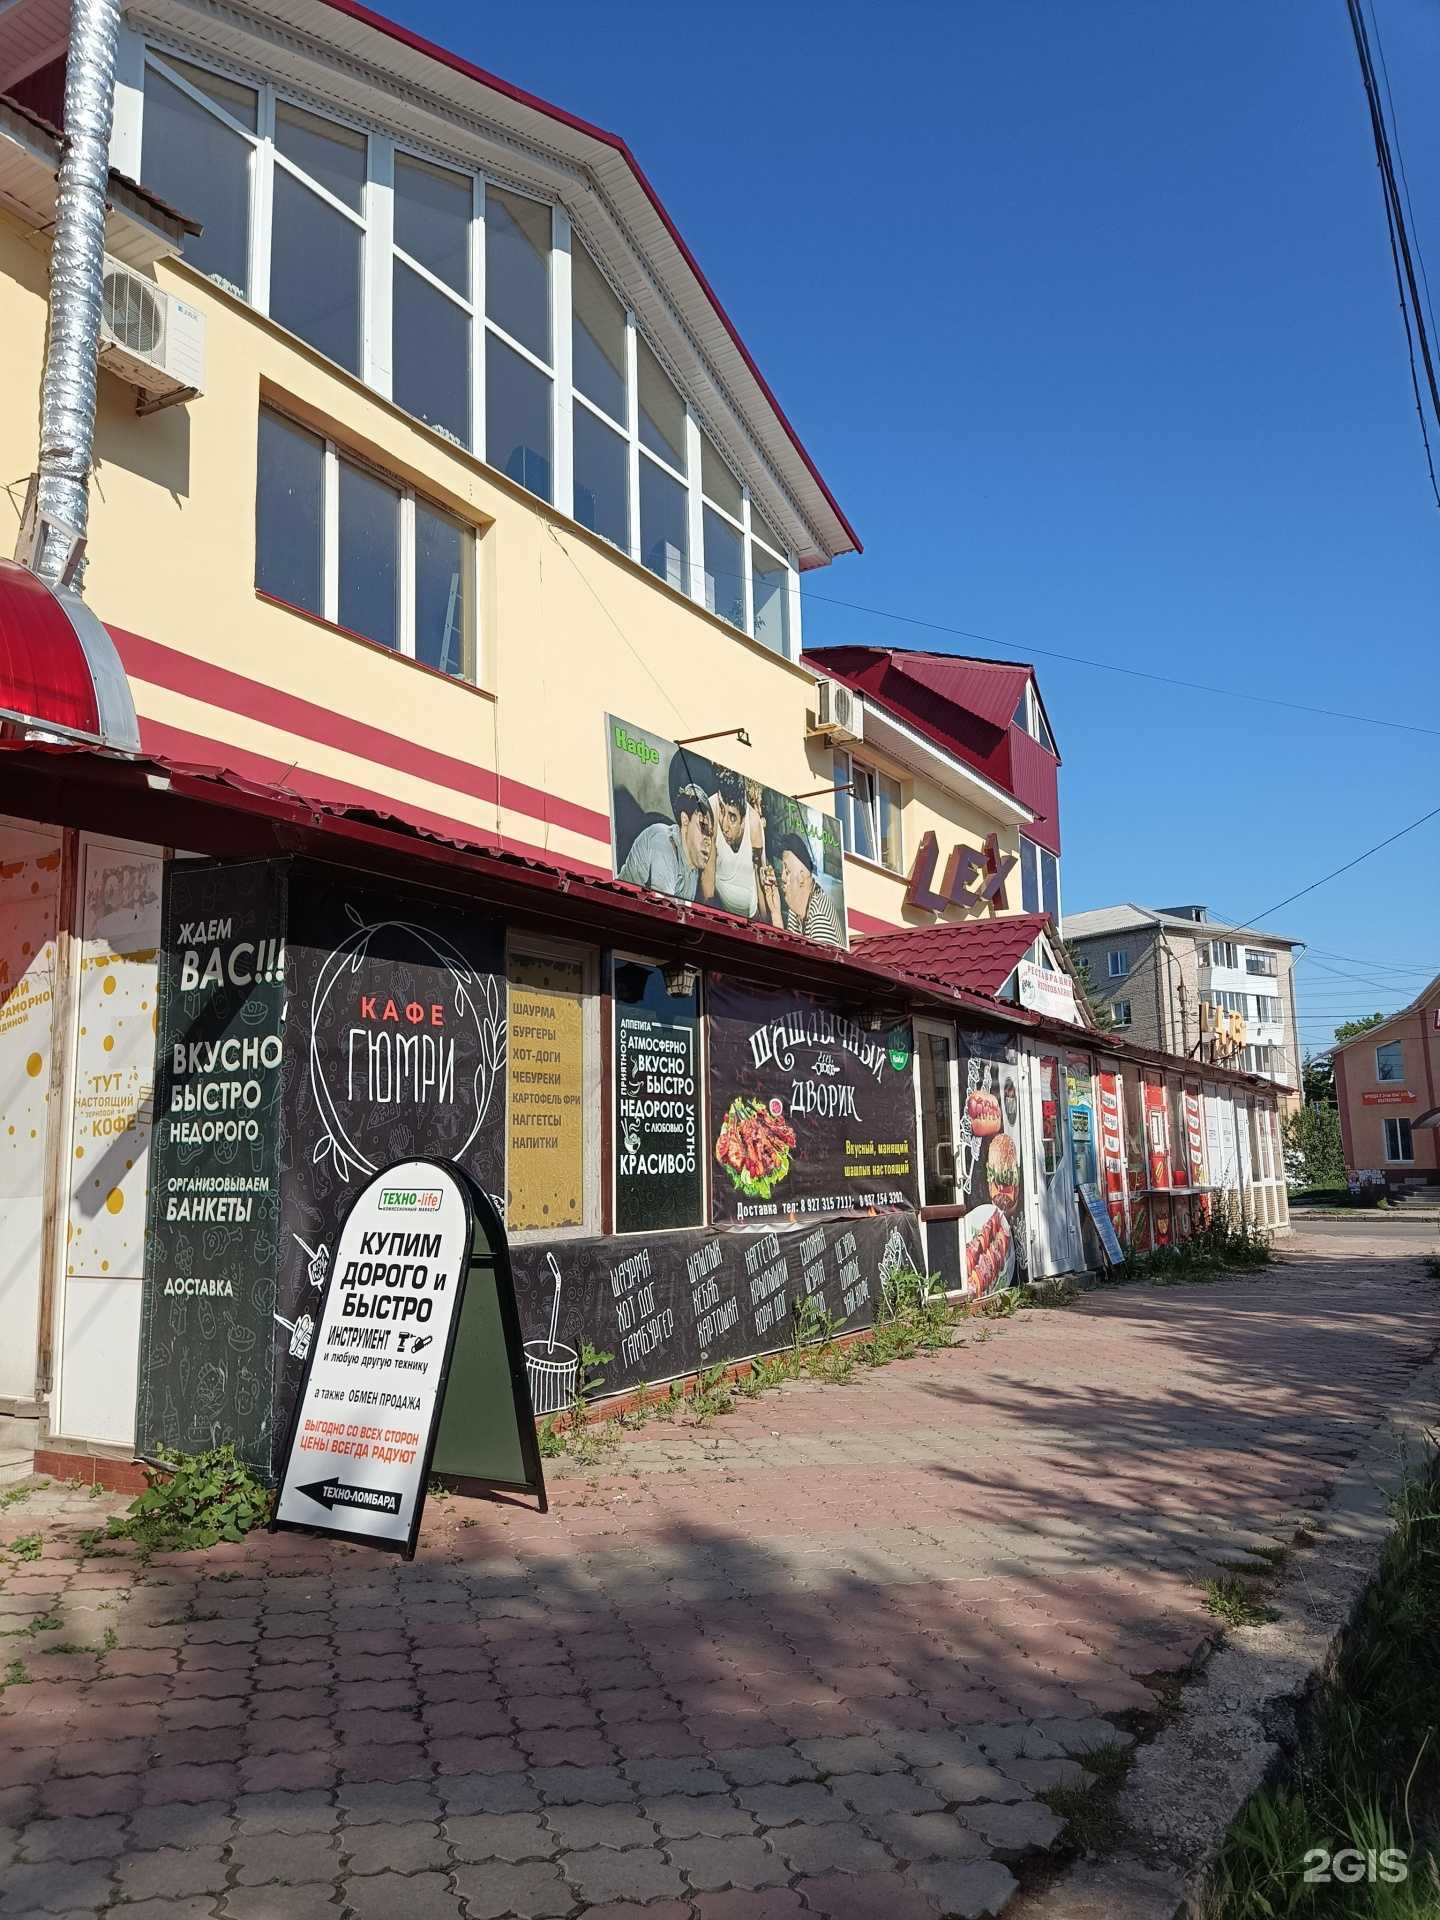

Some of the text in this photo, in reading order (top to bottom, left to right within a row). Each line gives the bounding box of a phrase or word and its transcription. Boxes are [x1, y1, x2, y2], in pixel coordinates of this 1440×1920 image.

[615, 725, 660, 765] Кафе
[905, 830, 1019, 912] LEX
[177, 918, 232, 945] ЖДЕМ
[181, 938, 286, 991] ВАС!!!
[360, 996, 444, 1026] КАФЕ
[512, 1002, 556, 1019] ШАУРМА
[512, 1025, 556, 1041] БУРГЕРЫ
[621, 1018, 652, 1032] АППЕТИТА
[173, 1035, 283, 1075] ВКУСНО
[512, 1048, 561, 1064] ХОТ-ДОГИ
[628, 1036, 687, 1055] АТМОСФЕРНО
[347, 1028, 454, 1105] ГЮМРИ
[638, 1054, 685, 1075] ВКУСНО
[93, 1072, 122, 1093] ТУТ
[512, 1071, 561, 1085] ЧЕБУРЕКИ
[646, 1075, 694, 1096] БЫСТРО
[75, 1095, 134, 1108] НАСТОЯЩИЙ
[171, 1080, 262, 1112] БЫСТРО
[512, 1092, 581, 1105] КАРТОФЕЛЬ ФРИ
[620, 1099, 684, 1119] НЕДОРОГО
[789, 1079, 863, 1122] ДВОРИК
[93, 1113, 136, 1137] КОФЕ
[170, 1119, 259, 1145] НЕДОРОГО
[512, 1114, 562, 1126] НАГГЕТСЫ
[644, 1122, 684, 1133] С ЛЮБОВЬЮ
[512, 1136, 558, 1149] НАПИТКИ
[685, 1104, 695, 1172] УЮТНО
[845, 1140, 876, 1158] Вкусный,
[620, 1154, 687, 1176] КРАСИВО
[844, 1160, 909, 1176] шашлык настоящий
[167, 1176, 269, 1193] ОРГАНИЗОВЫВАЕМ
[166, 1196, 252, 1223] БАНКЕТЫ
[737, 1202, 777, 1220] Доставка
[782, 1201, 799, 1214] тел:
[800, 1199, 806, 1212] 8
[807, 1198, 820, 1213] 927
[822, 1197, 834, 1210] 315
[859, 1194, 863, 1207] 8
[359, 1231, 442, 1258] КУПИМ
[744, 1232, 780, 1275] НАГГЕТСЫ
[610, 1248, 651, 1297] ШАУРМА
[686, 1239, 722, 1283] ШАШЛЫК
[164, 1278, 234, 1298] ДОСТАВКА
[340, 1261, 429, 1290] ДОРОГО
[750, 1257, 789, 1306] КРЫЛЫШКИ
[342, 1292, 433, 1322] БЫСТРО
[616, 1282, 655, 1333] ХОТ ДОГ
[692, 1276, 719, 1317] КЕБАБ
[697, 1296, 739, 1349] КАРТОШКА
[755, 1289, 787, 1336] КОРН ДОГ
[327, 1325, 391, 1351] ИНСТРУМЕНТ
[622, 1308, 673, 1368] ГАМБУРГЕР
[323, 1352, 429, 1374] и любую другую технику
[314, 1388, 421, 1411] а также ОБМЕН ПРОДАЖА
[304, 1419, 420, 1446] ВЫГОДНО СО ВСЕХ СТОРОН
[300, 1436, 416, 1464] ЦЕНЫ ВСЕГДА РАДУЮТ
